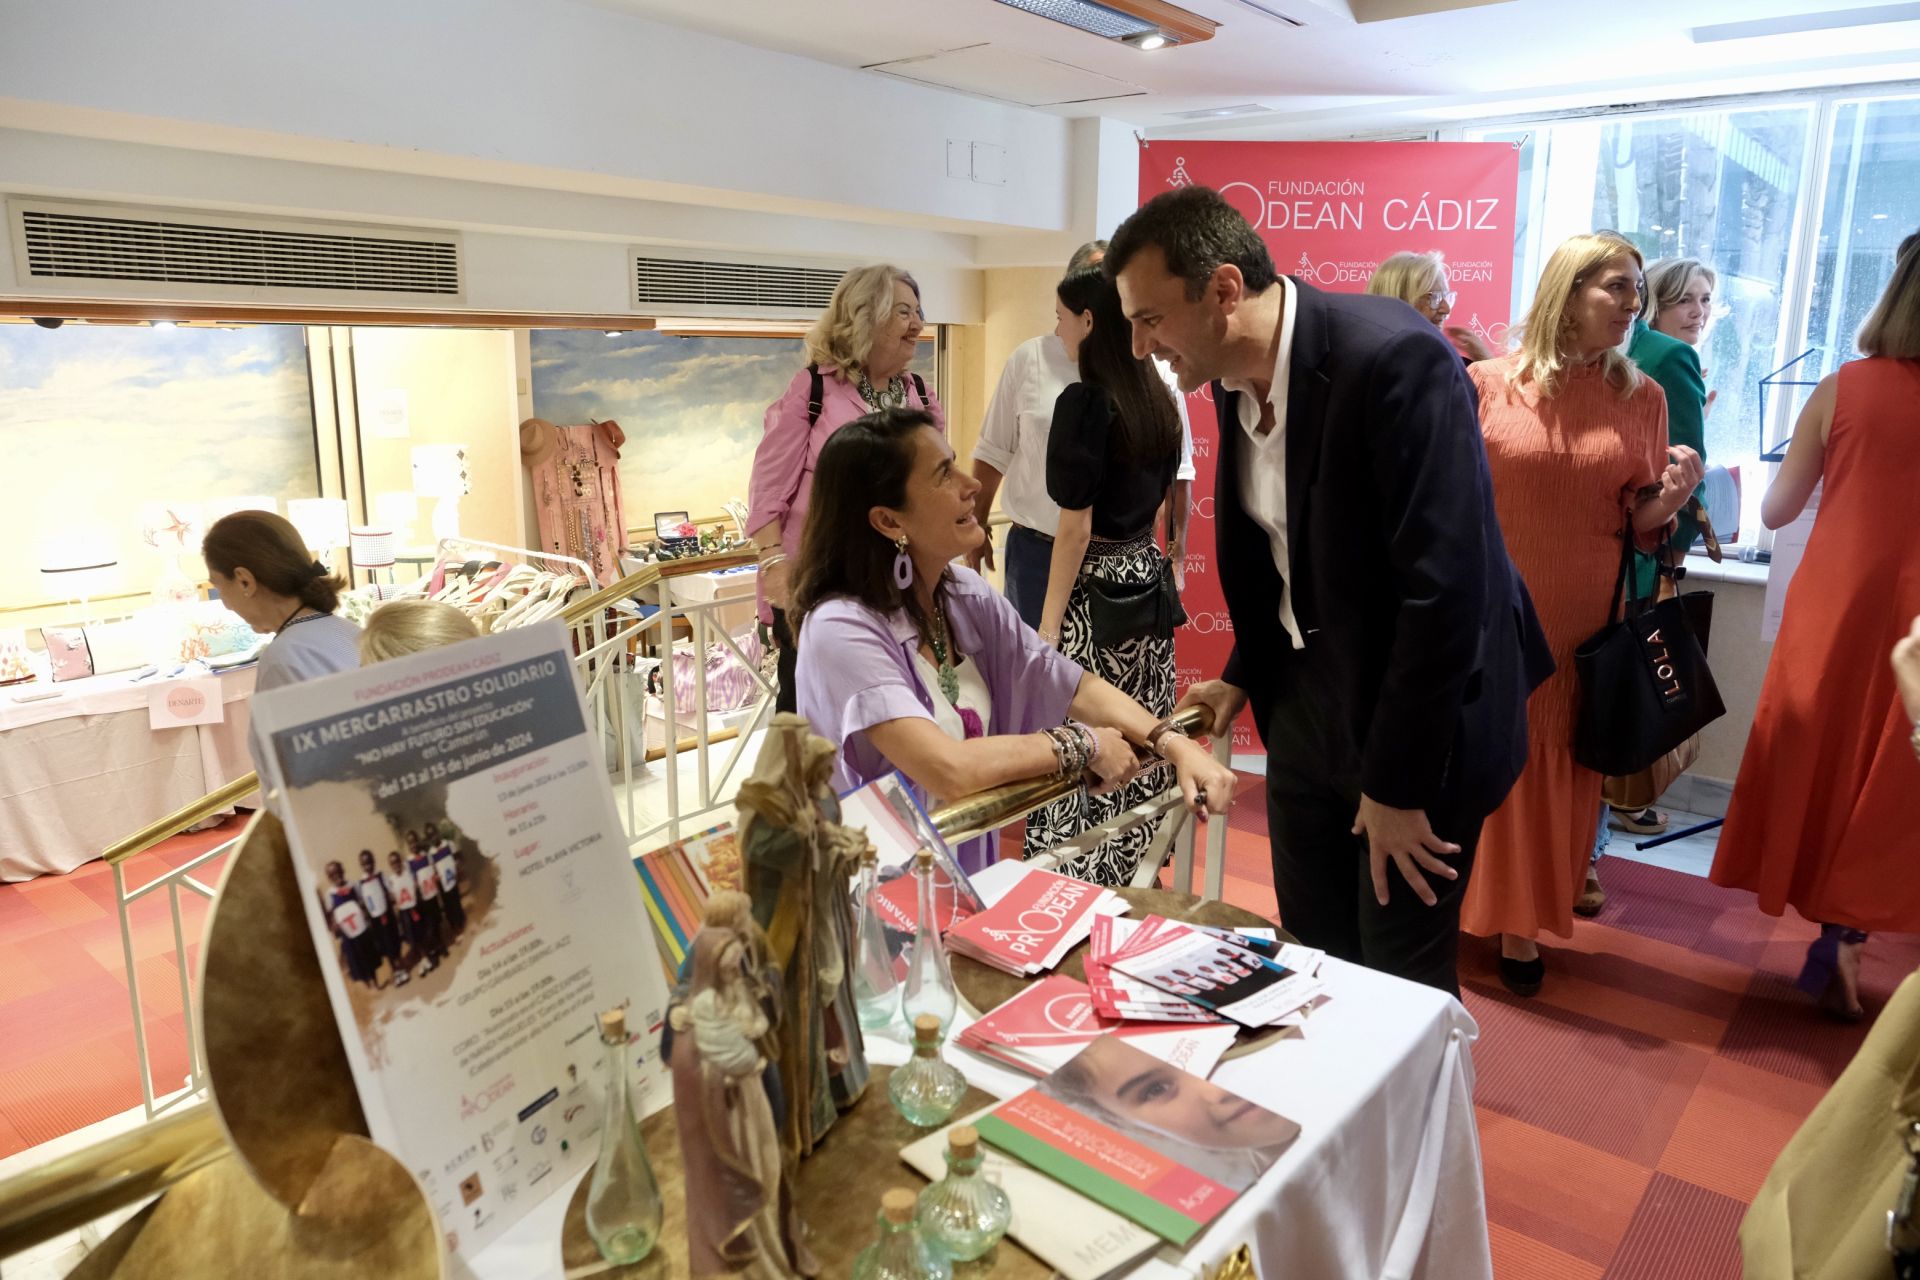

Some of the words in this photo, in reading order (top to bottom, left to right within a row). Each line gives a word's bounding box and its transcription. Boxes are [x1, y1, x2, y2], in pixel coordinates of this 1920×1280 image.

[1218, 181, 1363, 231] ODEAN
[1383, 192, 1500, 231] CÁDIZ
[1268, 178, 1365, 196] FUNDACIÓN
[1452, 261, 1493, 269] FUNDACIÓN
[1647, 628, 1680, 695] LOLA
[291, 732, 318, 754] IX
[319, 684, 471, 745] MERCARRASTRO
[474, 659, 556, 699] SOLIDARIO
[378, 779, 399, 799] del
[400, 771, 417, 791] 13
[417, 768, 430, 786] al
[430, 761, 446, 781] 15
[447, 754, 462, 773] de
[461, 745, 491, 772] junio
[492, 740, 505, 758] de
[504, 730, 534, 753] 2024
[407, 728, 453, 751] FUTURO
